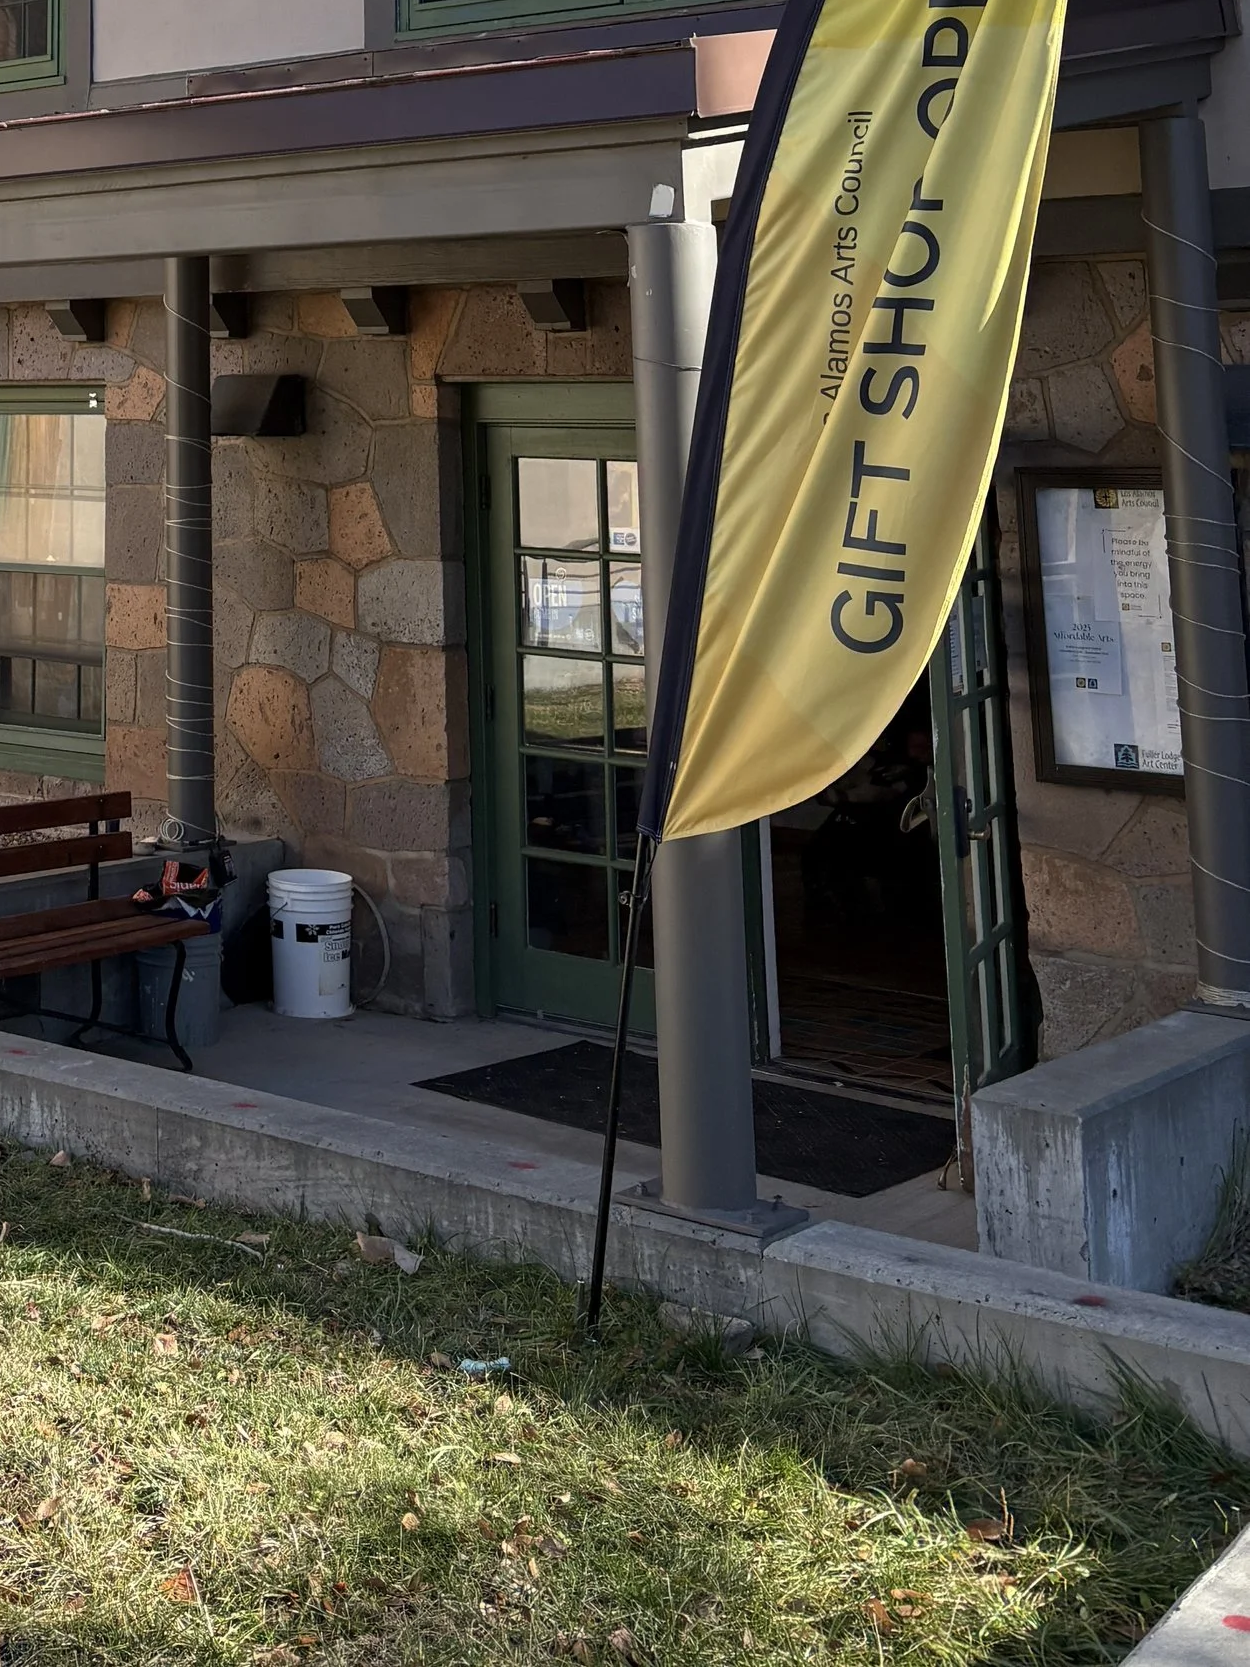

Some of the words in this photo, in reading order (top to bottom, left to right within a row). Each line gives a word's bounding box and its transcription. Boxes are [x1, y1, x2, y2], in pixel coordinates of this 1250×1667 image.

[834, 111, 873, 216] Council
[830, 226, 857, 285] Arts
[820, 293, 852, 401] Alamos
[1121, 498, 1135, 507] Arts
[1136, 498, 1159, 508] Council
[830, 440, 911, 654] GIFT
[1111, 537, 1137, 546] Please
[1138, 538, 1149, 546] be
[1111, 548, 1141, 556] mindful
[1142, 549, 1150, 557] of
[1125, 560, 1152, 569] energy
[1113, 570, 1128, 578] you
[1129, 570, 1150, 579] bring
[533, 583, 567, 607] OPEN
[1053, 631, 1095, 641] Affordable
[1098, 634, 1114, 643] Arts
[1142, 749, 1160, 759] Fuller
[1161, 751, 1181, 763] Lodge
[1142, 759, 1154, 769] Art
[1155, 759, 1178, 770] Center
